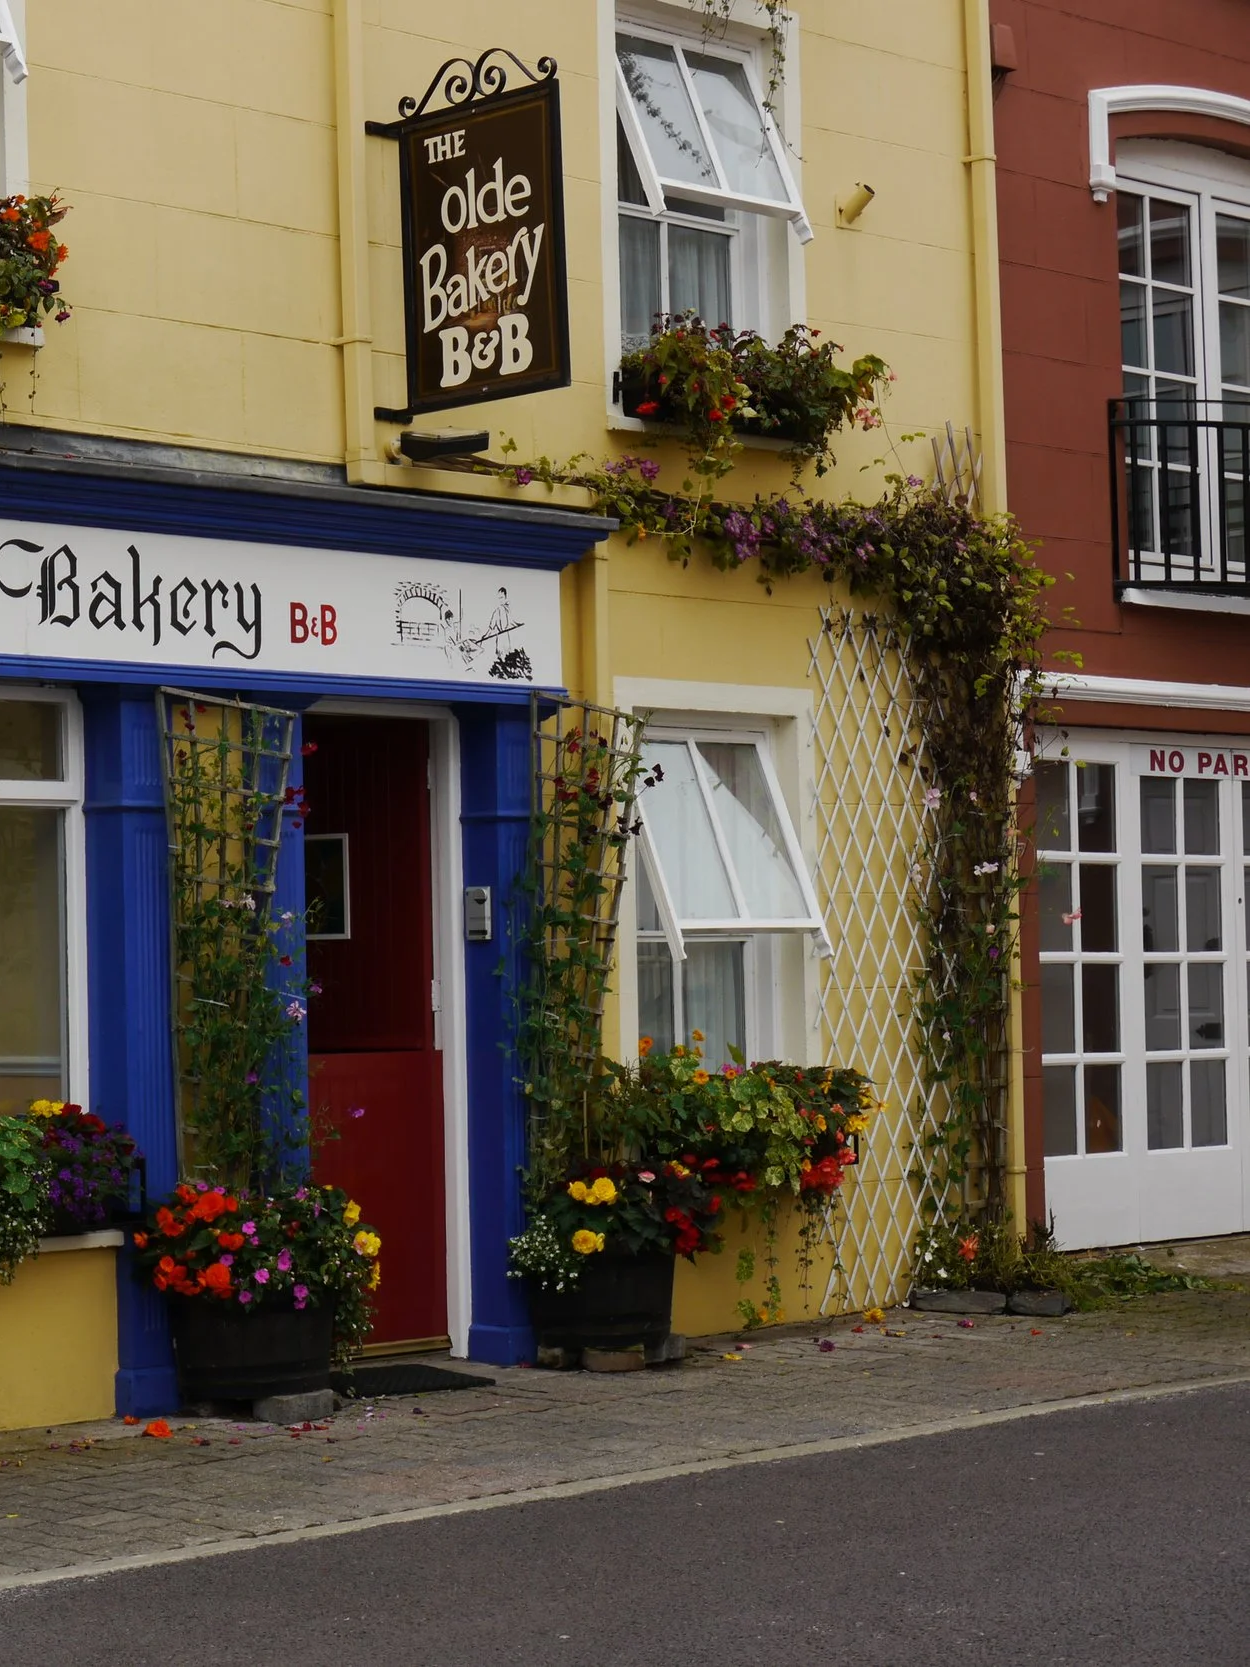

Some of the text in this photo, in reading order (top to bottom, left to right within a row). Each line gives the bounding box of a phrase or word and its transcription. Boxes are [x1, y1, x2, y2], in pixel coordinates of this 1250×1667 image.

[424, 129, 466, 165] THE
[419, 223, 545, 334] Bakery
[439, 313, 533, 388] B&B
[289, 602, 338, 646] B&B
[1150, 749, 1184, 773] NO
